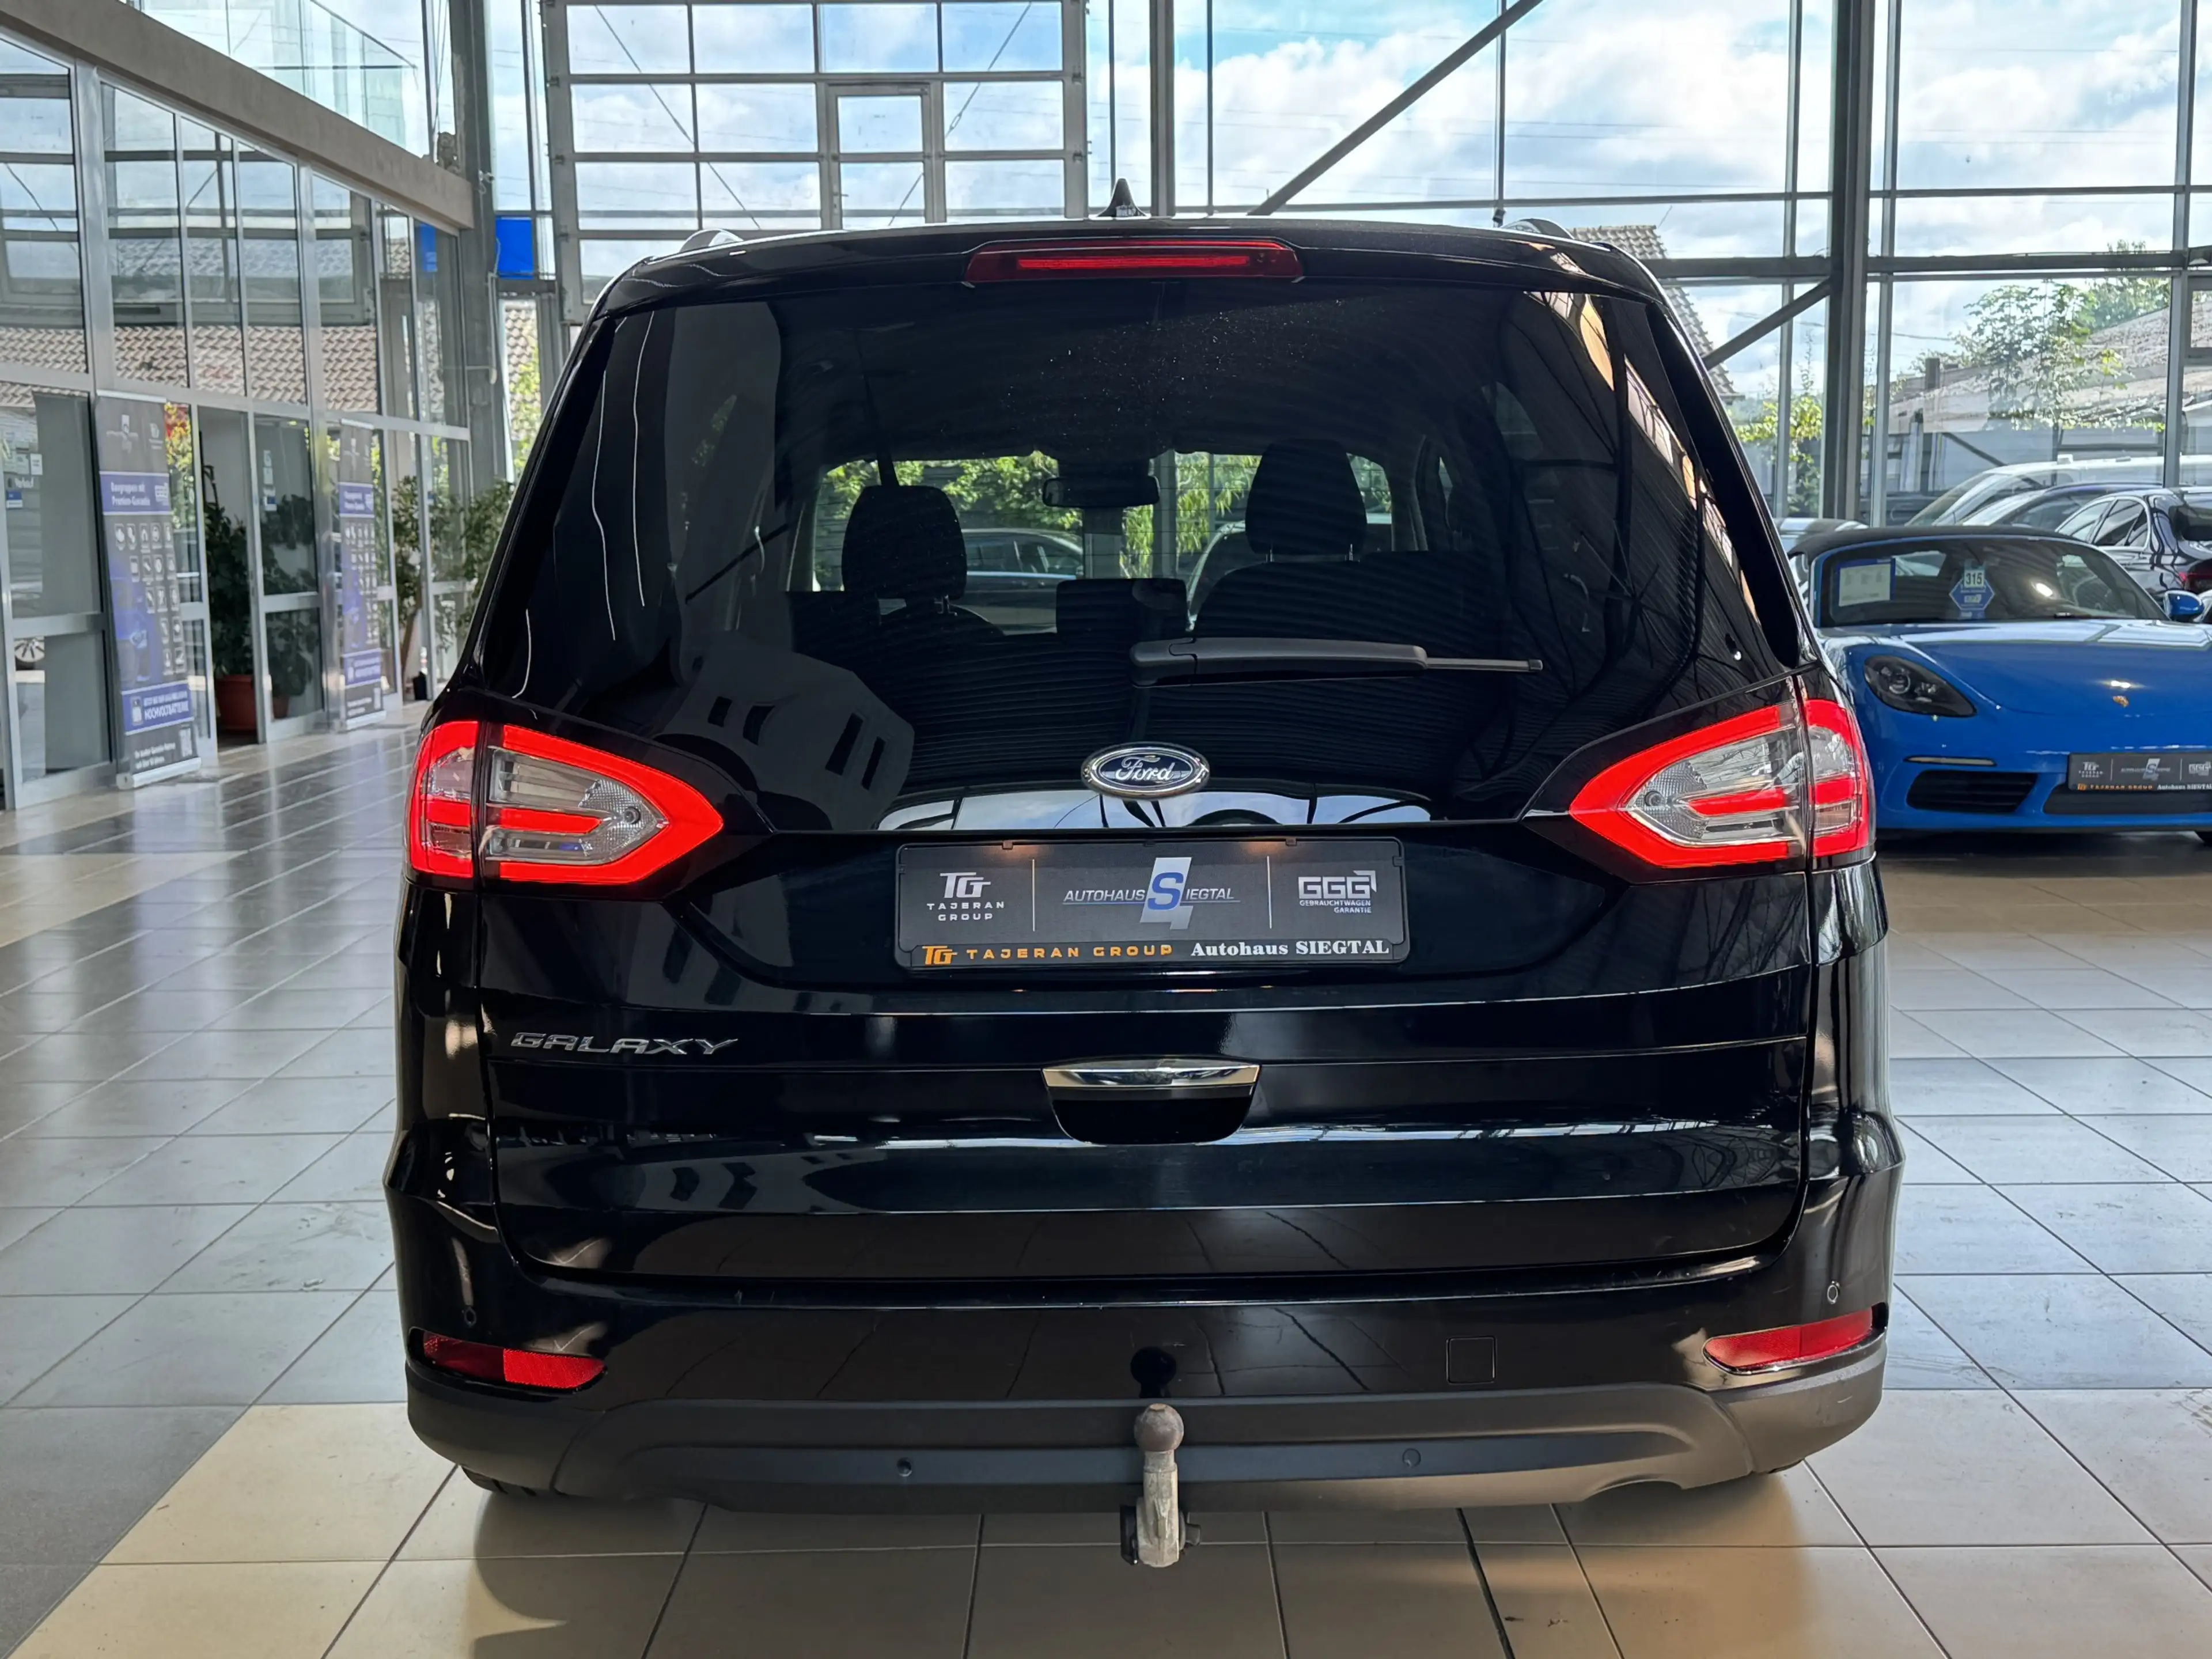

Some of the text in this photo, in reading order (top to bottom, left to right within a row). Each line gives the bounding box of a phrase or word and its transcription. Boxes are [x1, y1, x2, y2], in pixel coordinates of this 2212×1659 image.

[1965, 573, 1983, 585] 315
[1115, 755, 1176, 781] Ford
[1298, 876, 1370, 899] GGG
[1063, 889, 1145, 902] AUTOHAUS
[927, 902, 1004, 910] TAJERAN
[938, 913, 993, 921] GROUP
[966, 948, 1080, 959] TAJERAN
[1093, 945, 1173, 957] GROUP
[1191, 940, 1389, 956] Autohaus SIEGTAL
[510, 1032, 738, 1055] GALAXY
